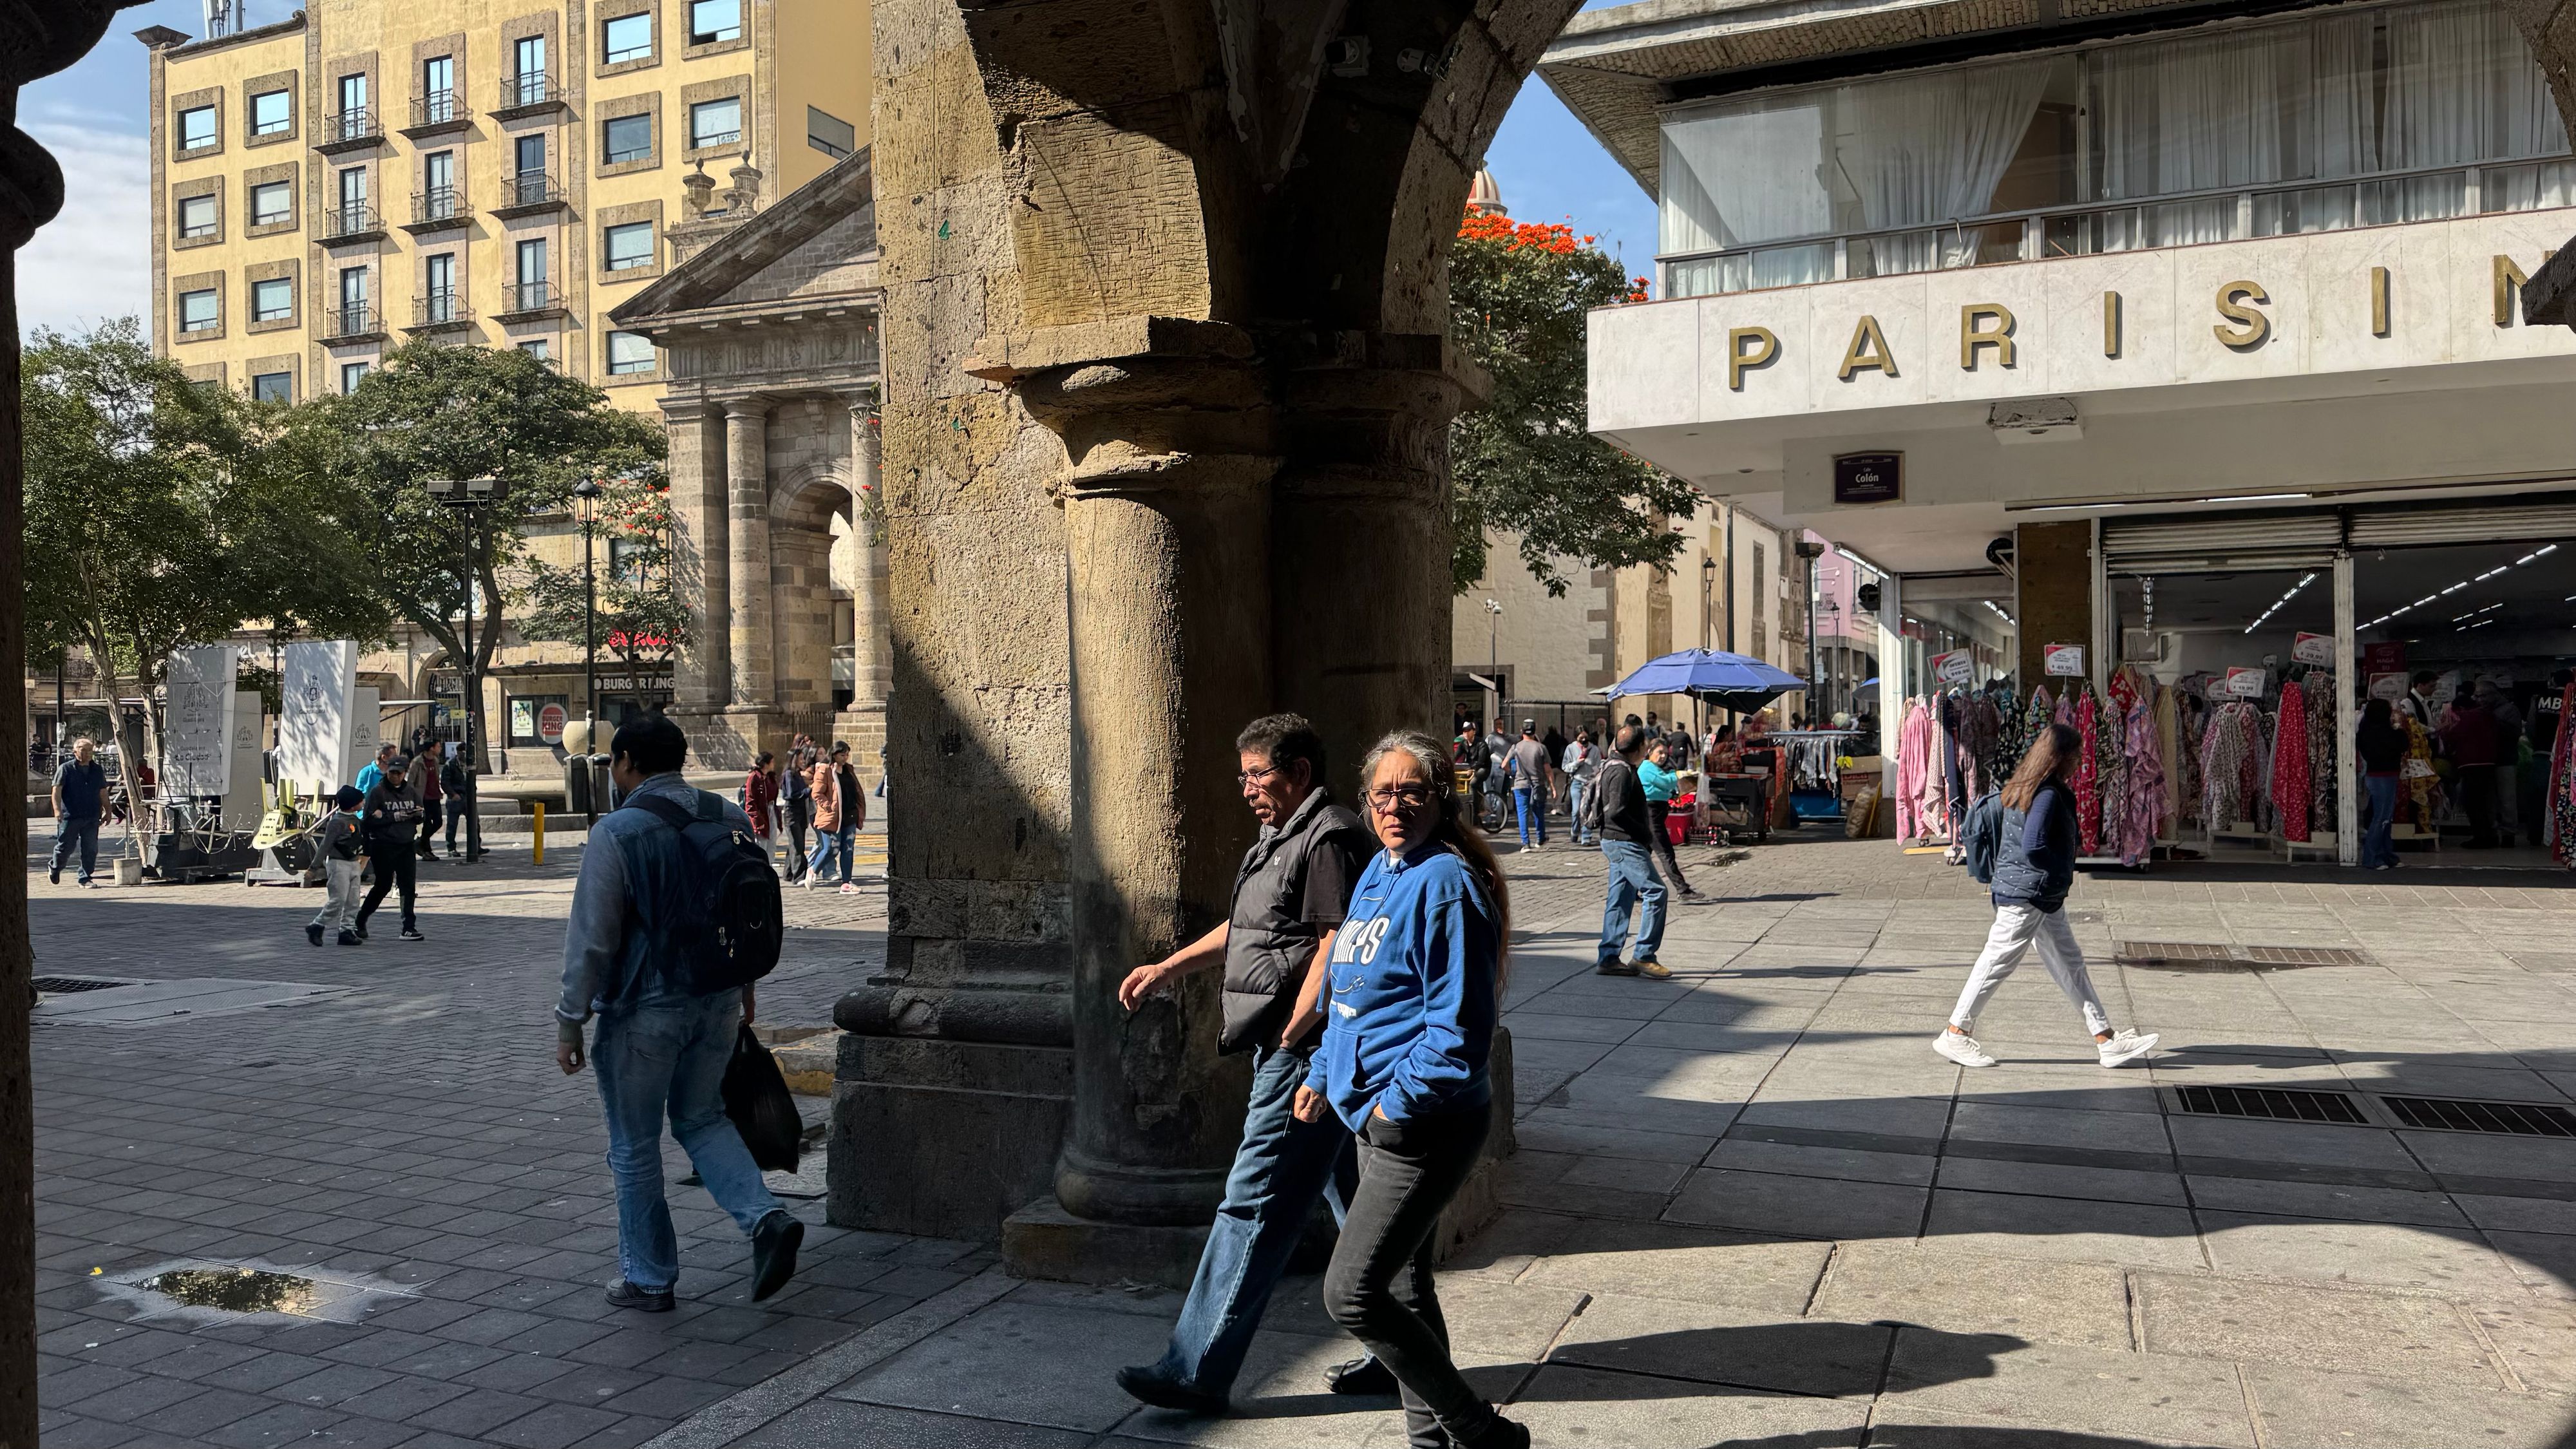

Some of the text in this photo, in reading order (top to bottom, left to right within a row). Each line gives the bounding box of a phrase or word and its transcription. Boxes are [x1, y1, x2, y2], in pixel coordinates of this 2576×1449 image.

[1855, 473, 1879, 483] Colón
[603, 677, 647, 690] BURGR
[542, 721, 563, 731] KING
